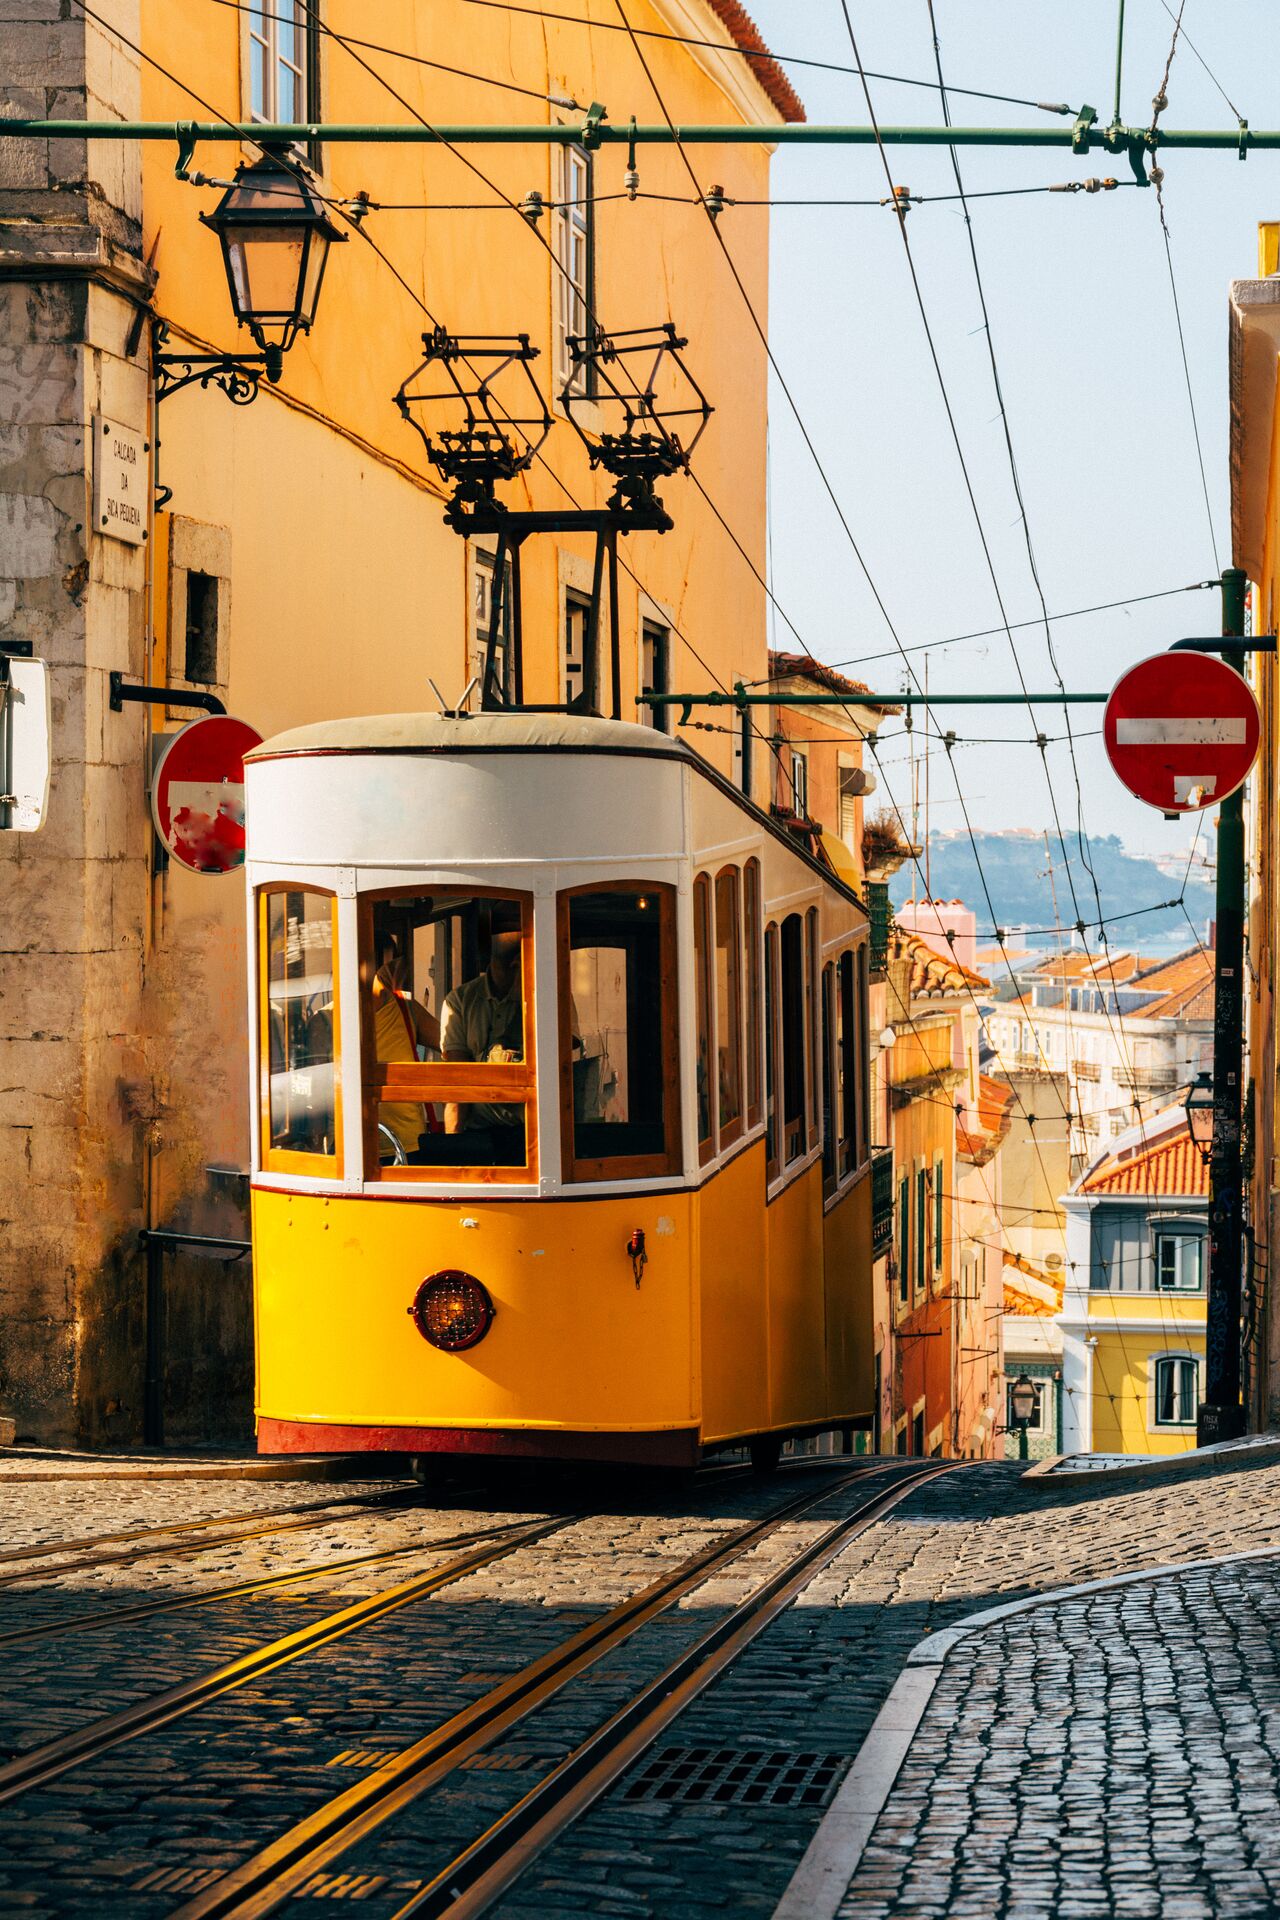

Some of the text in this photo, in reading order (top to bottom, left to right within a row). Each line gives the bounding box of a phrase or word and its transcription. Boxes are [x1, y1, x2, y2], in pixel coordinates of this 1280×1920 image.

[121, 473, 128, 492] DA
[107, 498, 140, 526] BICA PEQUENA
